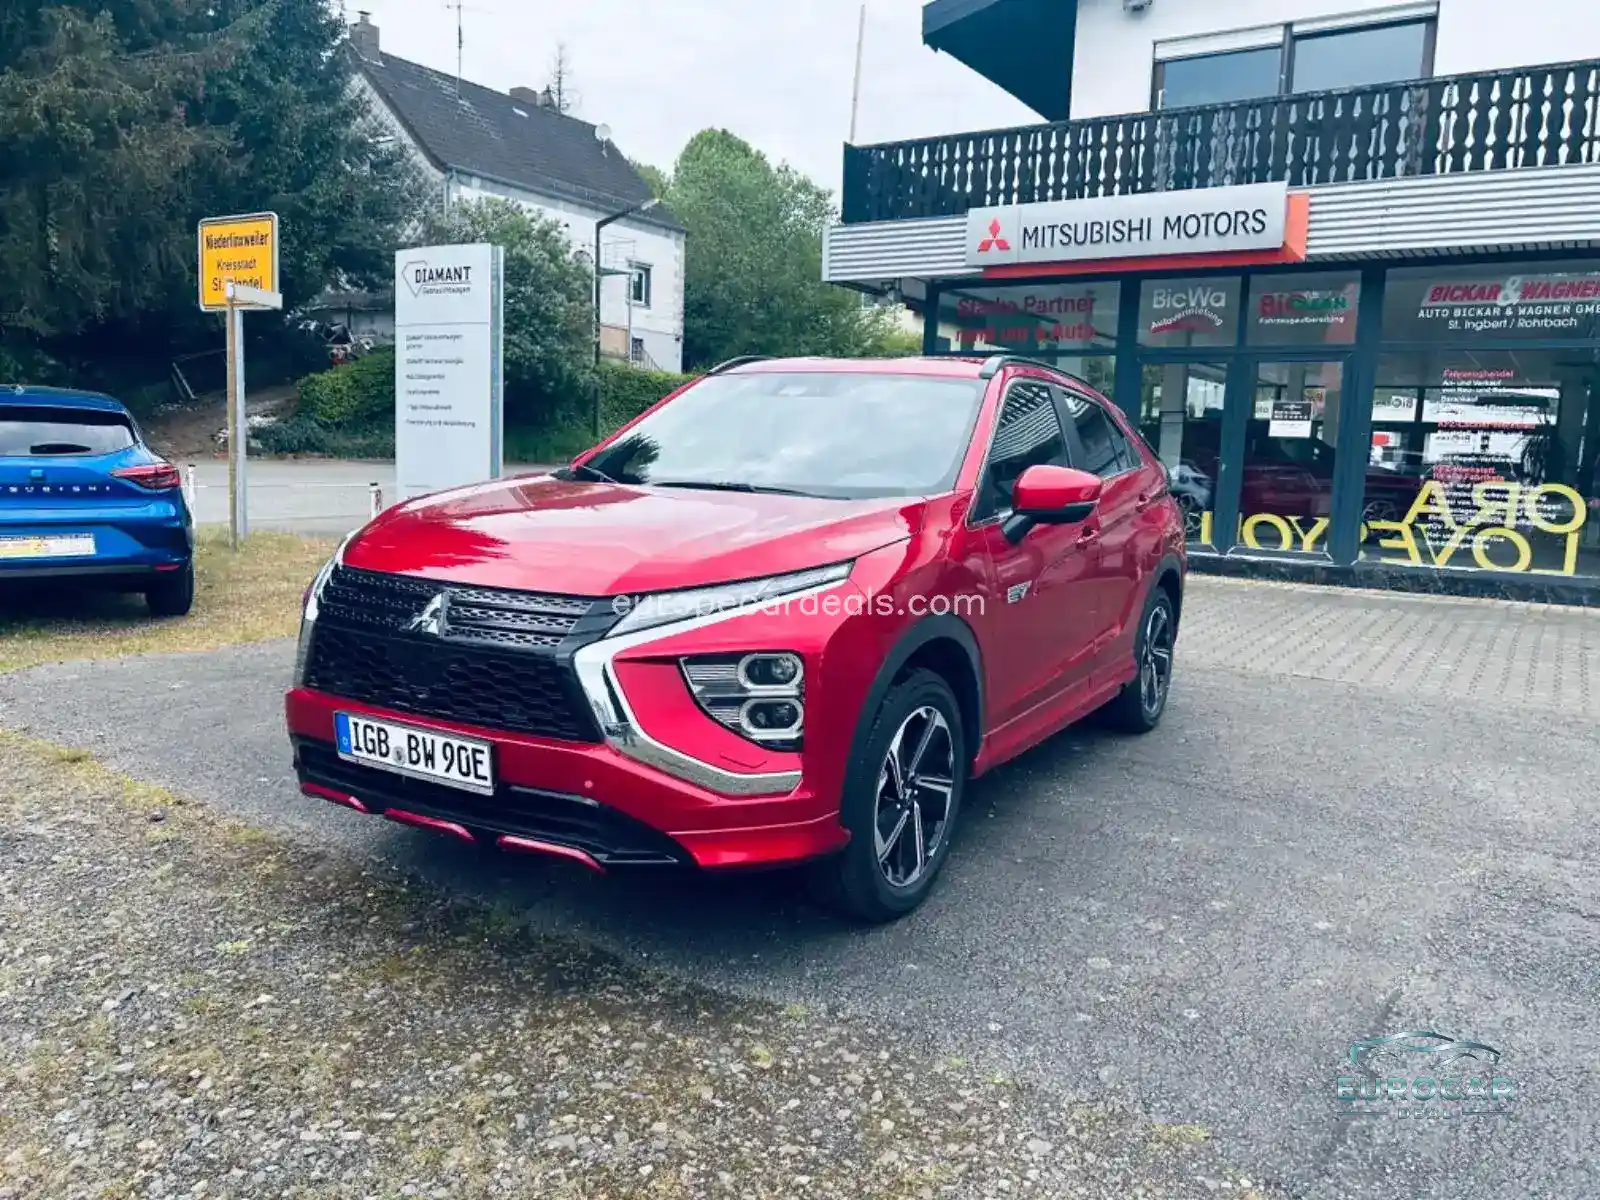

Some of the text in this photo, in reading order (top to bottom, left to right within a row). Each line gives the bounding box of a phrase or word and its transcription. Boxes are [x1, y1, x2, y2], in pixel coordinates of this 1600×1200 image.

[1022, 208, 1268, 250] MITSUBISHI MOTORS
[217, 258, 257, 271] Kreisstadt
[415, 266, 472, 283] DIAMANT
[212, 276, 263, 291] St. endel
[1428, 284, 1502, 302] BICKAR
[1497, 276, 1523, 306] &
[1024, 296, 1095, 314] Partner
[1153, 287, 1226, 309] BicWa
[1418, 308, 1449, 318] AUTO
[1453, 306, 1501, 317] BICKAR
[1505, 306, 1514, 316] &
[1518, 305, 1571, 316] WAGNER
[1448, 320, 1461, 330] St.
[1465, 319, 1508, 331] Ingbert
[1517, 317, 1578, 328] Rohrbach
[0, 485, 111, 494] SUBISHI
[352, 721, 488, 781] IGB BW 90E
